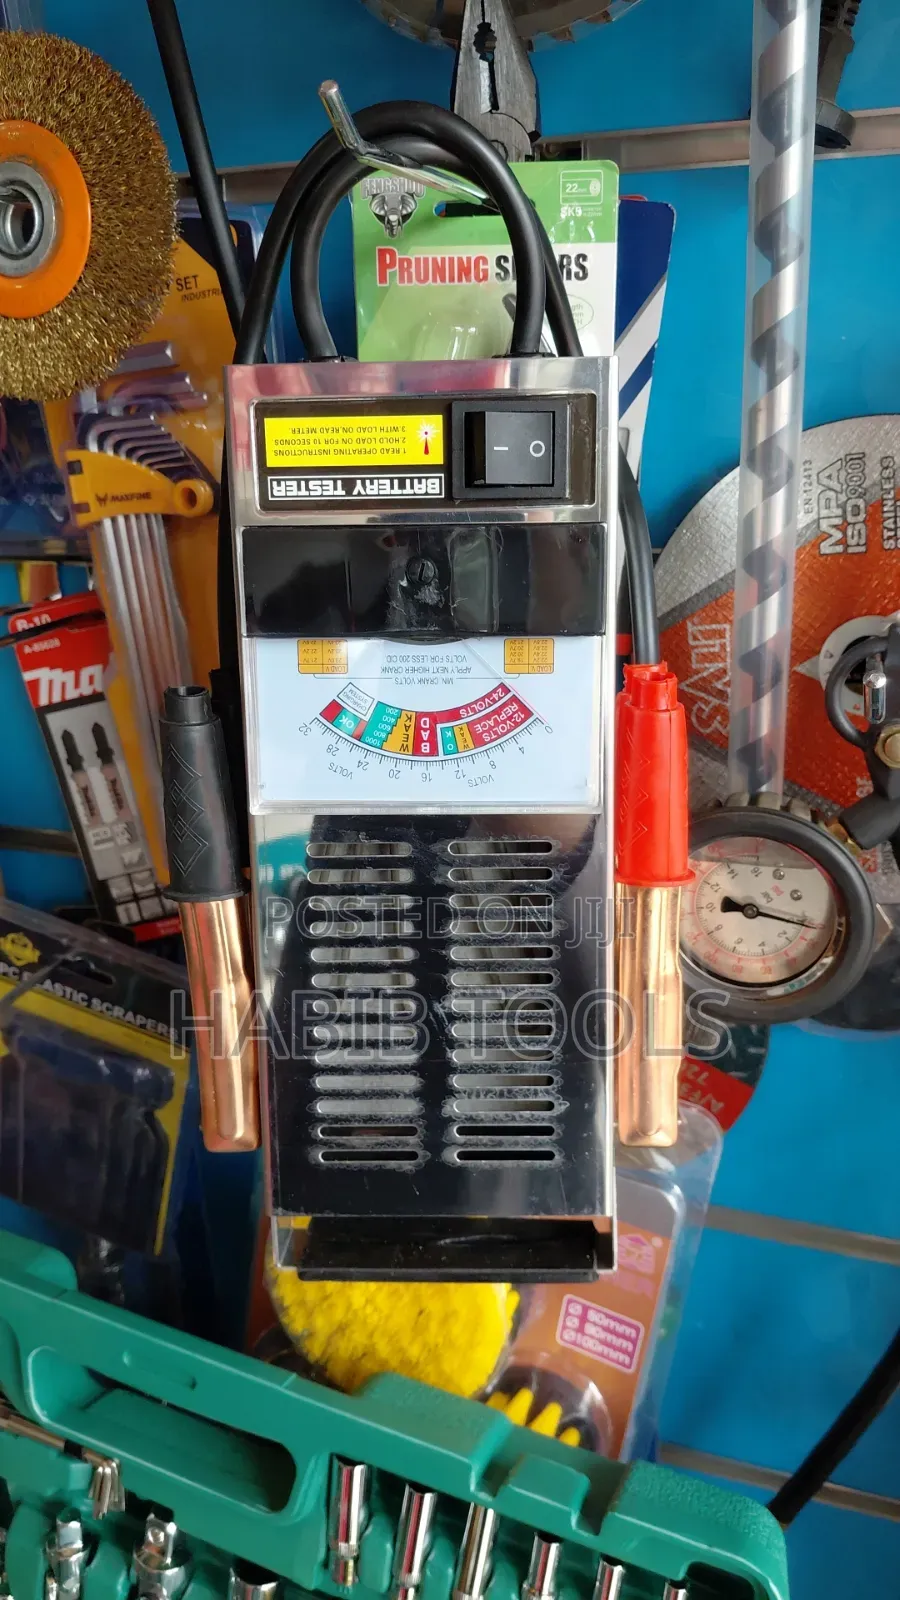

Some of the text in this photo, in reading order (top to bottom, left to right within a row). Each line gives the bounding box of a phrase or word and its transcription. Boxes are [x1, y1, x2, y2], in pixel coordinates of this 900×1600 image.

[376, 246, 490, 287] PRUNING
[176, 274, 199, 292] SET
[181, 287, 223, 302] INDUSTRI
[379, 425, 406, 433] 3.WITH
[379, 436, 406, 444] 2.HOLD
[379, 447, 406, 455] 1.READ
[802, 459, 813, 495] 12413
[272, 478, 440, 497] BATTERY TESTER
[816, 458, 845, 556] MPA
[844, 452, 868, 554] ISO9001
[879, 456, 897, 550] STAINLESS
[398, 655, 410, 663] 200
[411, 655, 428, 663] LESS
[430, 655, 443, 663] FOR
[445, 654, 467, 663] VOLTS
[380, 666, 472, 674] APPLY NEXT HIGHER CRANK
[394, 677, 416, 685] VOLTS
[417, 677, 439, 685] CRANK
[342, 691, 367, 712] CHARGING
[348, 688, 368, 704] SYSTEM
[459, 687, 505, 718] 24-VOLTS
[385, 707, 399, 715] 200
[338, 715, 355, 729] OK
[382, 715, 396, 723] 400
[474, 701, 519, 734] REPLACE
[298, 722, 312, 736] 32
[378, 722, 391, 731] 600
[482, 711, 525, 742] 12-VOLTS
[544, 725, 554, 734] 0
[373, 730, 387, 738] 800
[399, 713, 413, 753] WEAK
[420, 717, 430, 753] BAD
[457, 726, 471, 749] WEAK
[365, 736, 381, 746] 1000
[445, 730, 454, 750] OK
[326, 744, 339, 757] 28
[518, 745, 525, 755] 4
[327, 762, 353, 780] VOLTS
[356, 759, 370, 771] 24
[488, 760, 497, 770] 8
[388, 769, 401, 780] 20
[421, 772, 433, 782] 16
[454, 769, 466, 780] 12
[467, 774, 495, 788] VOLTS
[727, 867, 739, 879] 14
[750, 867, 763, 877] 16
[709, 882, 721, 893] 12
[706, 902, 715, 912] 10
[22, 970, 89, 1007] PASTIC
